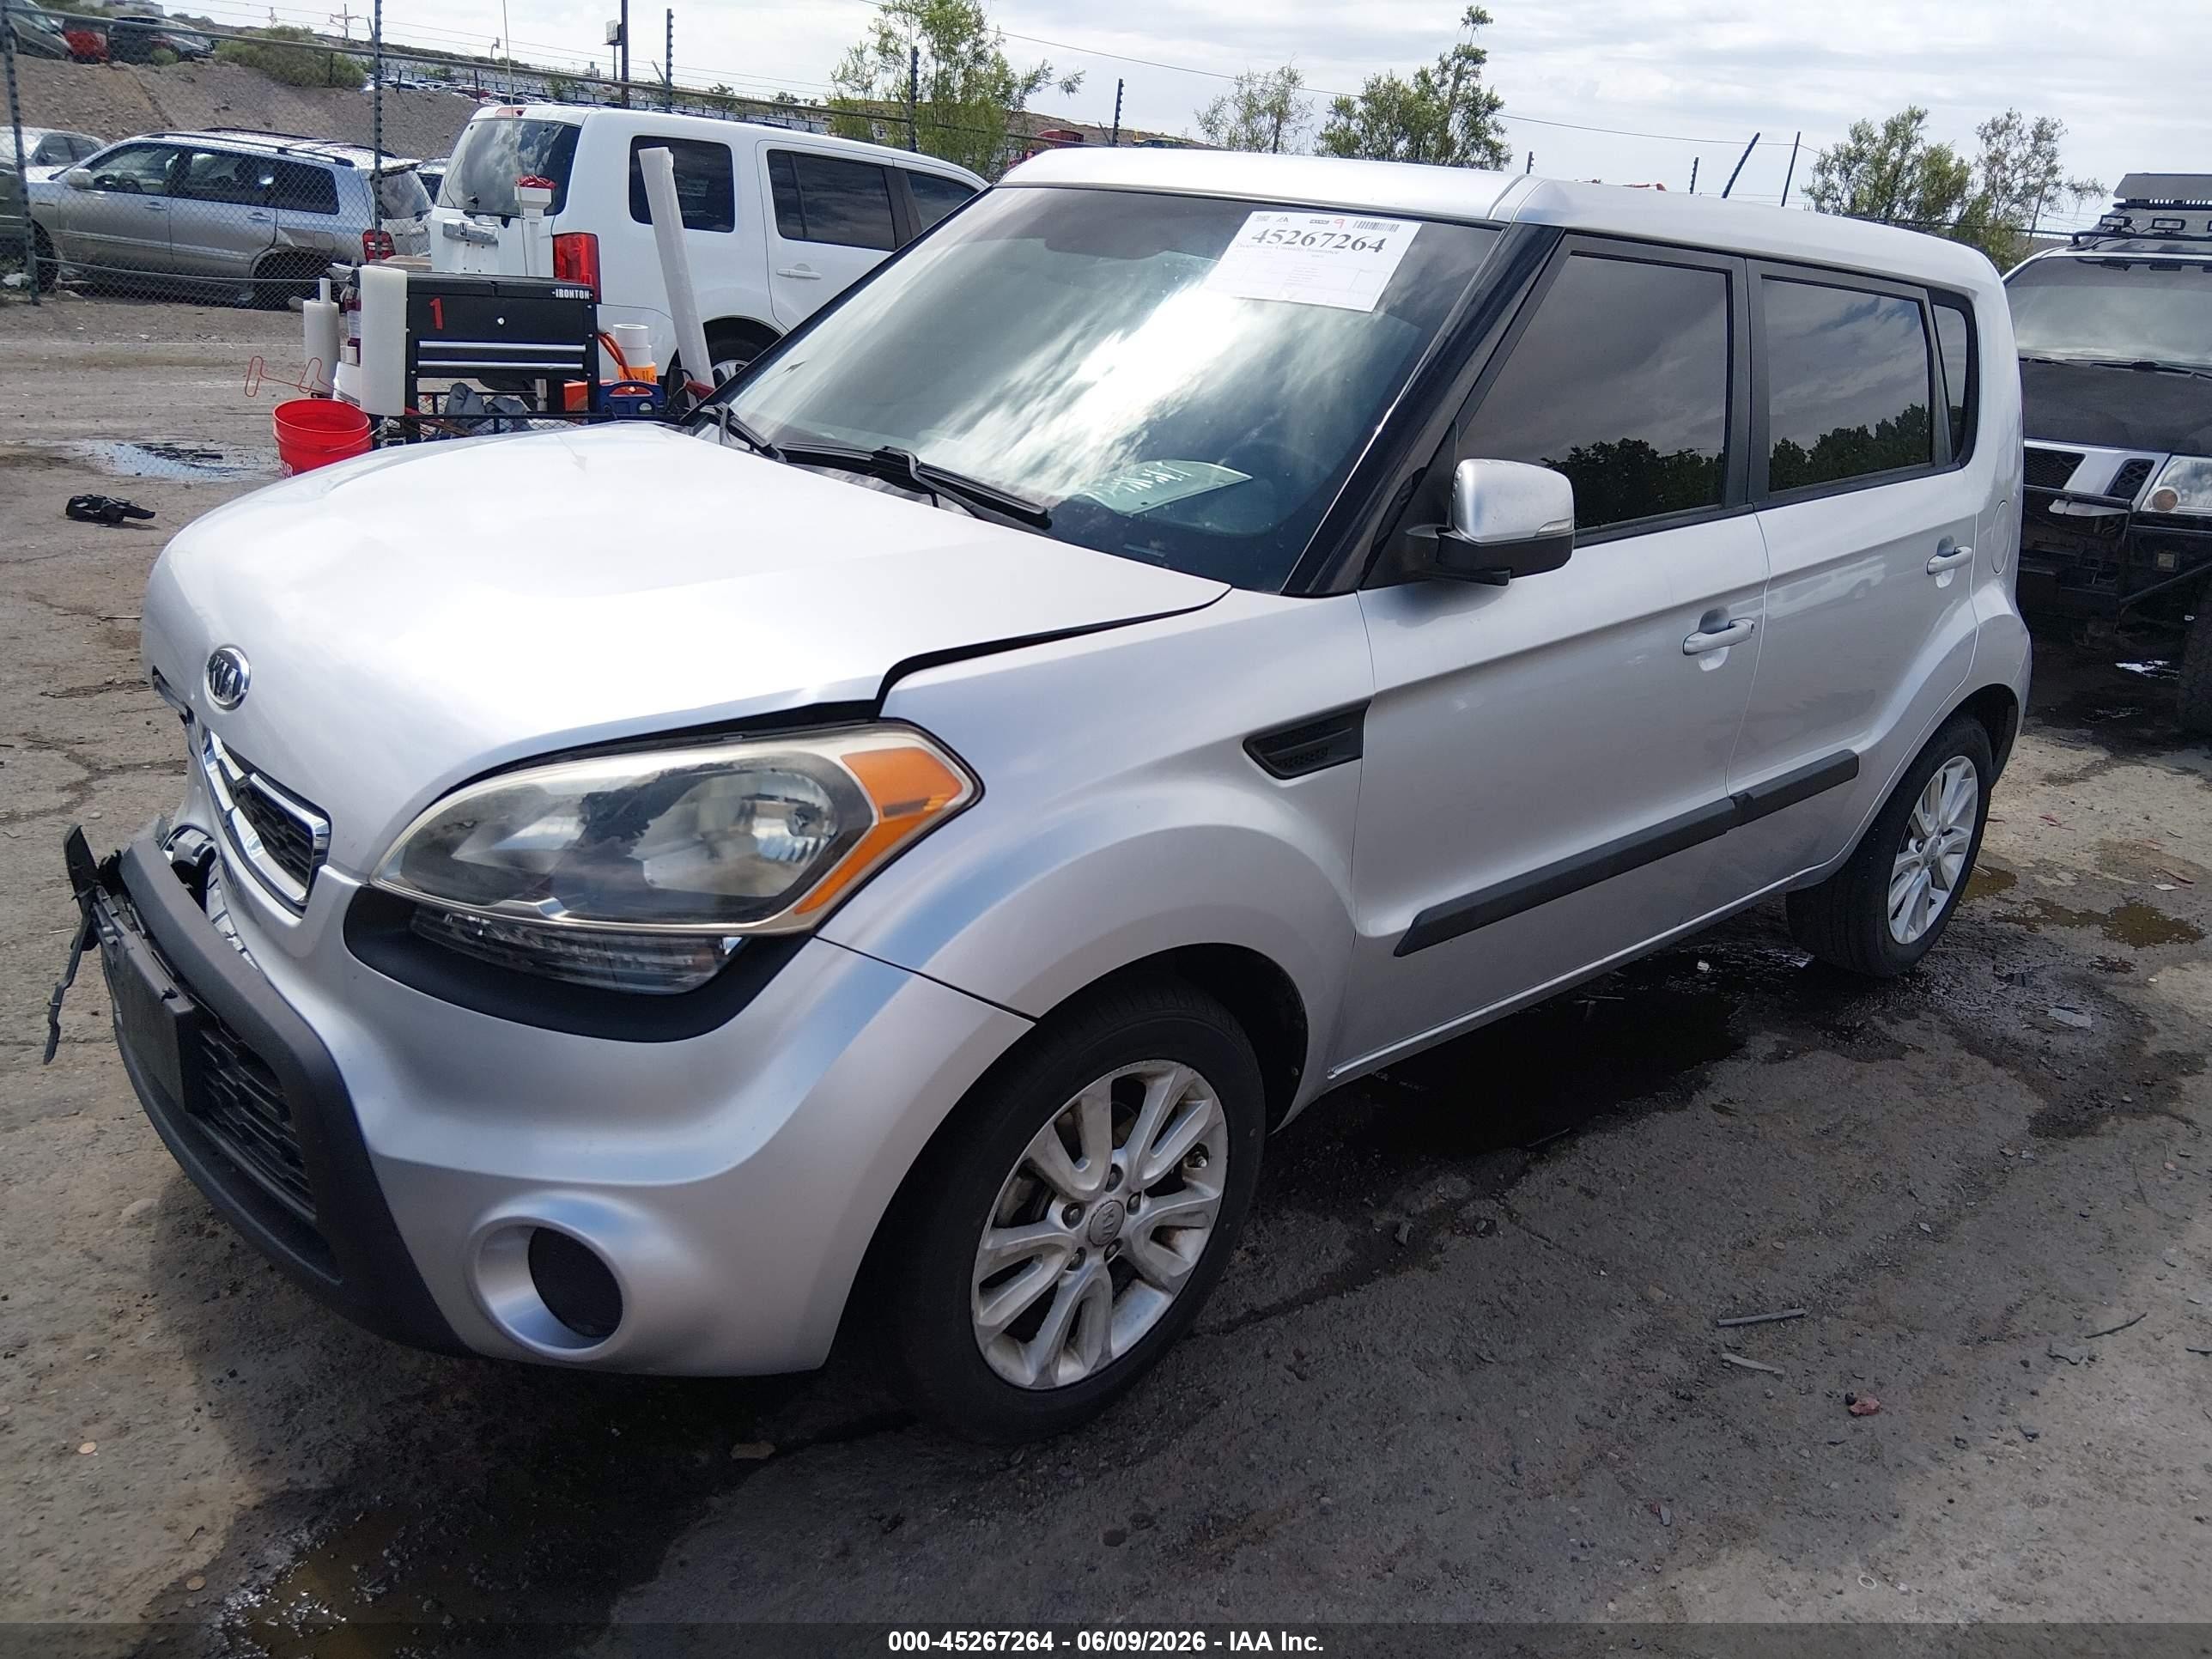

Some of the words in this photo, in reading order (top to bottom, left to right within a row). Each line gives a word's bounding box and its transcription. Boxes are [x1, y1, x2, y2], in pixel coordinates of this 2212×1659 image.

[1252, 228, 1387, 252] 45267264
[555, 289, 590, 300] IRONTON
[430, 298, 443, 330] 1
